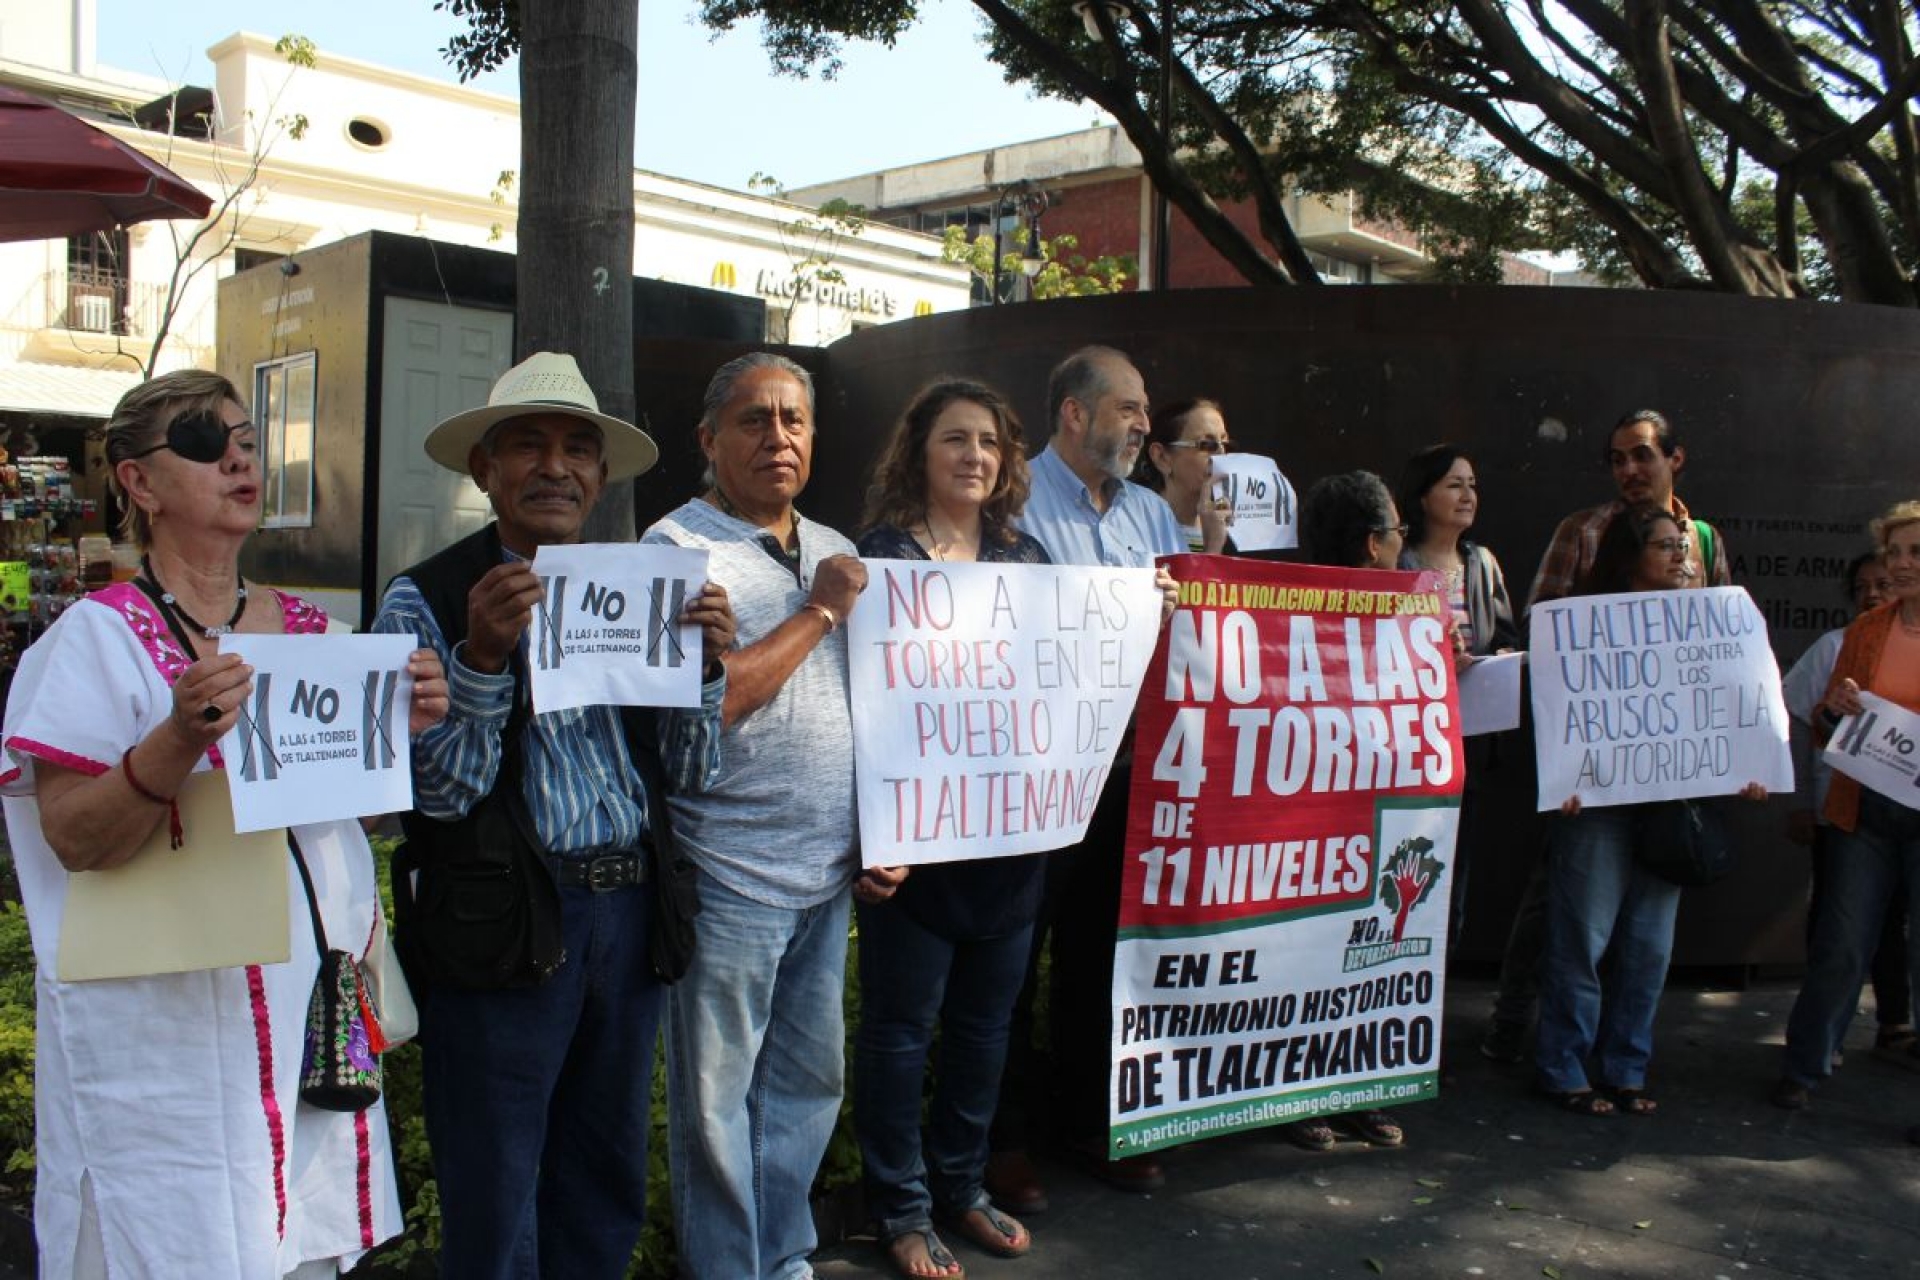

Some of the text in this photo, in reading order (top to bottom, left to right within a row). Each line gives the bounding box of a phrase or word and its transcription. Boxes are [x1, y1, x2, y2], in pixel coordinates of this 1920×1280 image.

[1246, 475, 1266, 499] NO
[1756, 555, 1789, 577] DE
[580, 581, 625, 621] NO
[884, 567, 1129, 631] NO A LAS
[1178, 581, 1440, 615] NO A LA VIOLACION DE USO DE SUELO
[565, 629, 572, 640] A
[575, 628, 591, 639] LAS
[602, 628, 641, 639] TORRES
[1545, 594, 1754, 652] TLALTENANGO
[565, 644, 641, 655] DE TLALTENANGO
[873, 639, 1132, 690] TORRES EN EL
[1165, 608, 1447, 704] NO A LAS
[1561, 642, 1744, 694] UNIDO CONTRA
[1678, 665, 1711, 686] LOS
[290, 679, 340, 724] NO
[1564, 682, 1771, 745] ABUSOS DE LA
[280, 734, 287, 747] A
[288, 733, 307, 747] LAS
[317, 730, 357, 744] TORRES
[915, 699, 1114, 757] PUEBLO DE
[1152, 701, 1453, 798] 4 TORRES
[1883, 726, 1914, 755] NO
[281, 748, 357, 764] DE TLALTENANGO
[1575, 735, 1731, 789] AUTORIDAD
[1151, 801, 1195, 839] DE
[1138, 834, 1370, 907] 11 NIVELES
[1347, 916, 1379, 946] NO
[1153, 949, 1259, 990] EN EL
[1121, 970, 1433, 1046] PATRIMONIO HISTORICO
[1117, 1015, 1433, 1115] DE TLALTENANGO
[1128, 1081, 1420, 1148] v.participantestlaltenango@gmail.com
